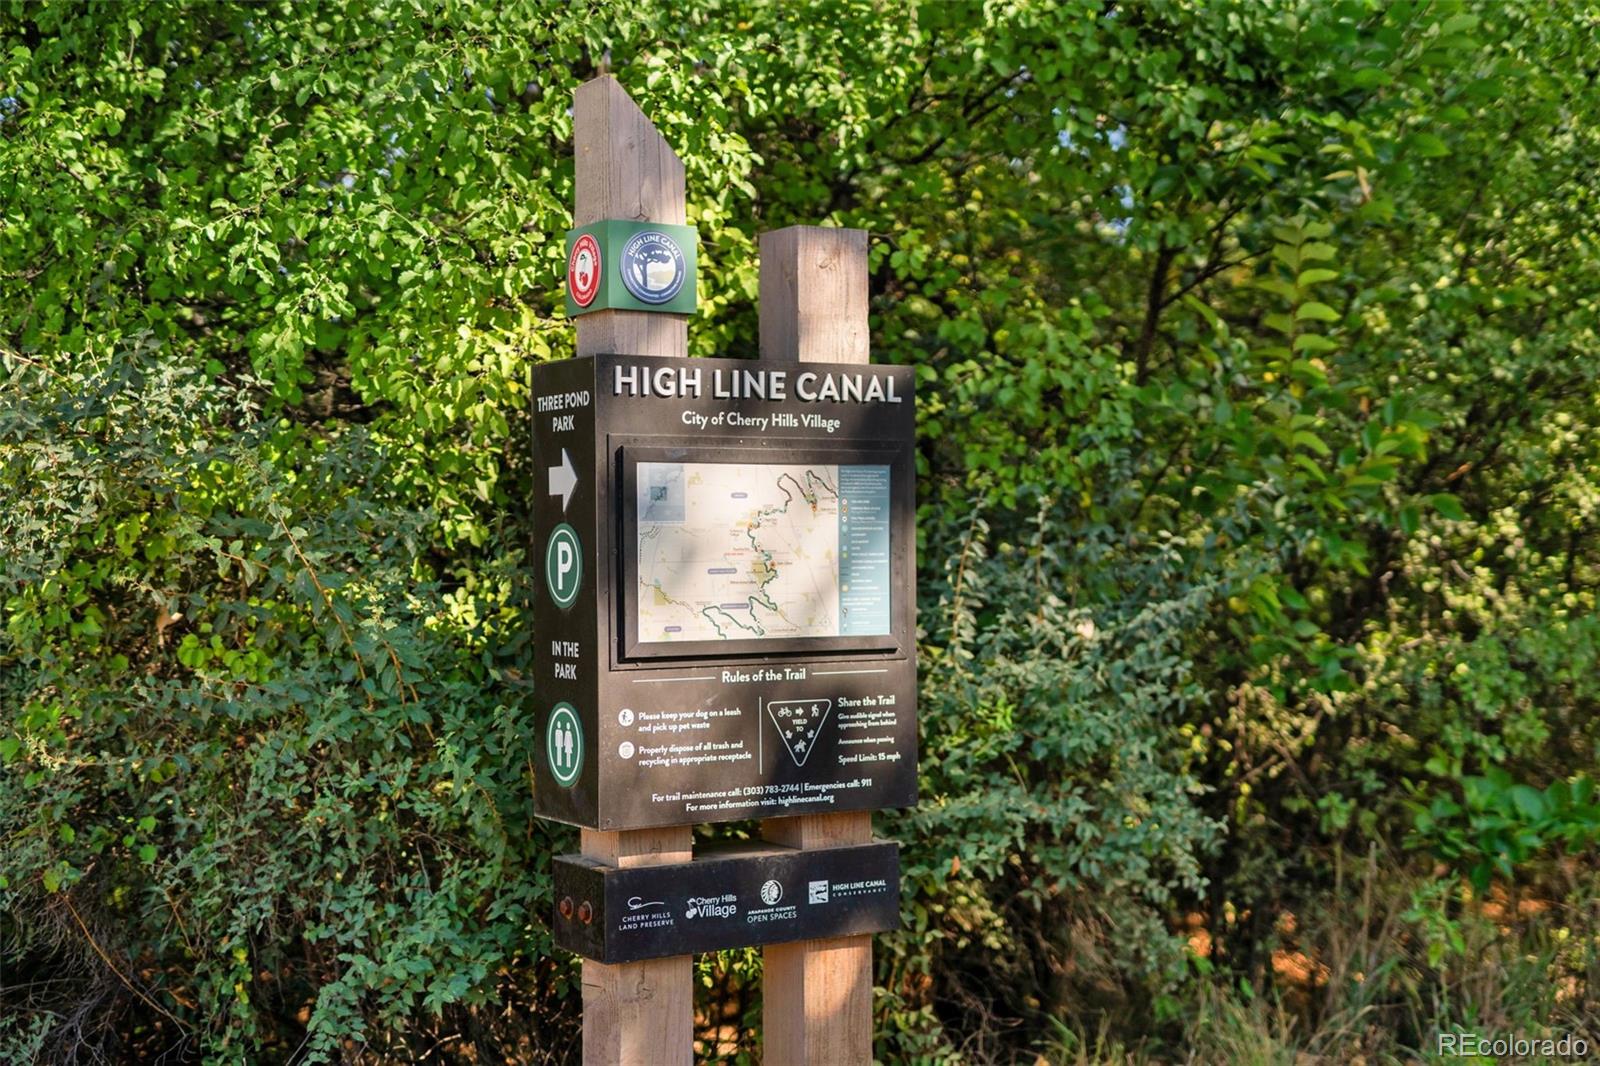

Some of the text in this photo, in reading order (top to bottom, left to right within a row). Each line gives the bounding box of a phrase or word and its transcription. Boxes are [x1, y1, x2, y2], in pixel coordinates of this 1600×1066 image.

[628, 234, 681, 260] HIGH LINE CANAL
[614, 365, 903, 403] HIGH LINE CANAL
[537, 390, 590, 412] THREE POND
[552, 414, 575, 432] PARK
[681, 410, 841, 432] City of Cherry Hills Village
[557, 541, 573, 590] P
[551, 640, 579, 658] IN THE
[554, 662, 577, 680] PARK
[721, 668, 806, 683] Rules of the Trail
[837, 695, 895, 708] Share the Trail
[639, 711, 660, 720] Please
[661, 711, 678, 721] keep
[679, 711, 694, 721] your
[695, 709, 708, 719] dog
[724, 707, 741, 716] leash
[850, 711, 867, 719] audible
[868, 711, 881, 720] signal
[638, 721, 710, 733] and pick up pet waste
[792, 718, 808, 726] YIELD
[837, 718, 897, 730] approaching from behind
[837, 737, 863, 745] Announce
[876, 736, 895, 744] passing
[638, 740, 743, 757] Properly dispose of all trash and
[638, 751, 752, 768] recycling in appropriate receptacle
[837, 751, 901, 765] Speed Limit: 15 mph
[652, 778, 872, 803] For trail maintenance call: (303) 783-2744 Emergencies call: 911
[686, 793, 834, 812] For more information visit: highlinecanal.org
[832, 883, 849, 891] HIGH
[865, 880, 886, 888] CANAL
[696, 894, 737, 906] Cherry Hills
[622, 911, 671, 923] CHERRY HILLS
[697, 904, 737, 919] Village
[747, 911, 797, 923] OPEN SPACES
[618, 919, 674, 931] LAND PRESERVE
